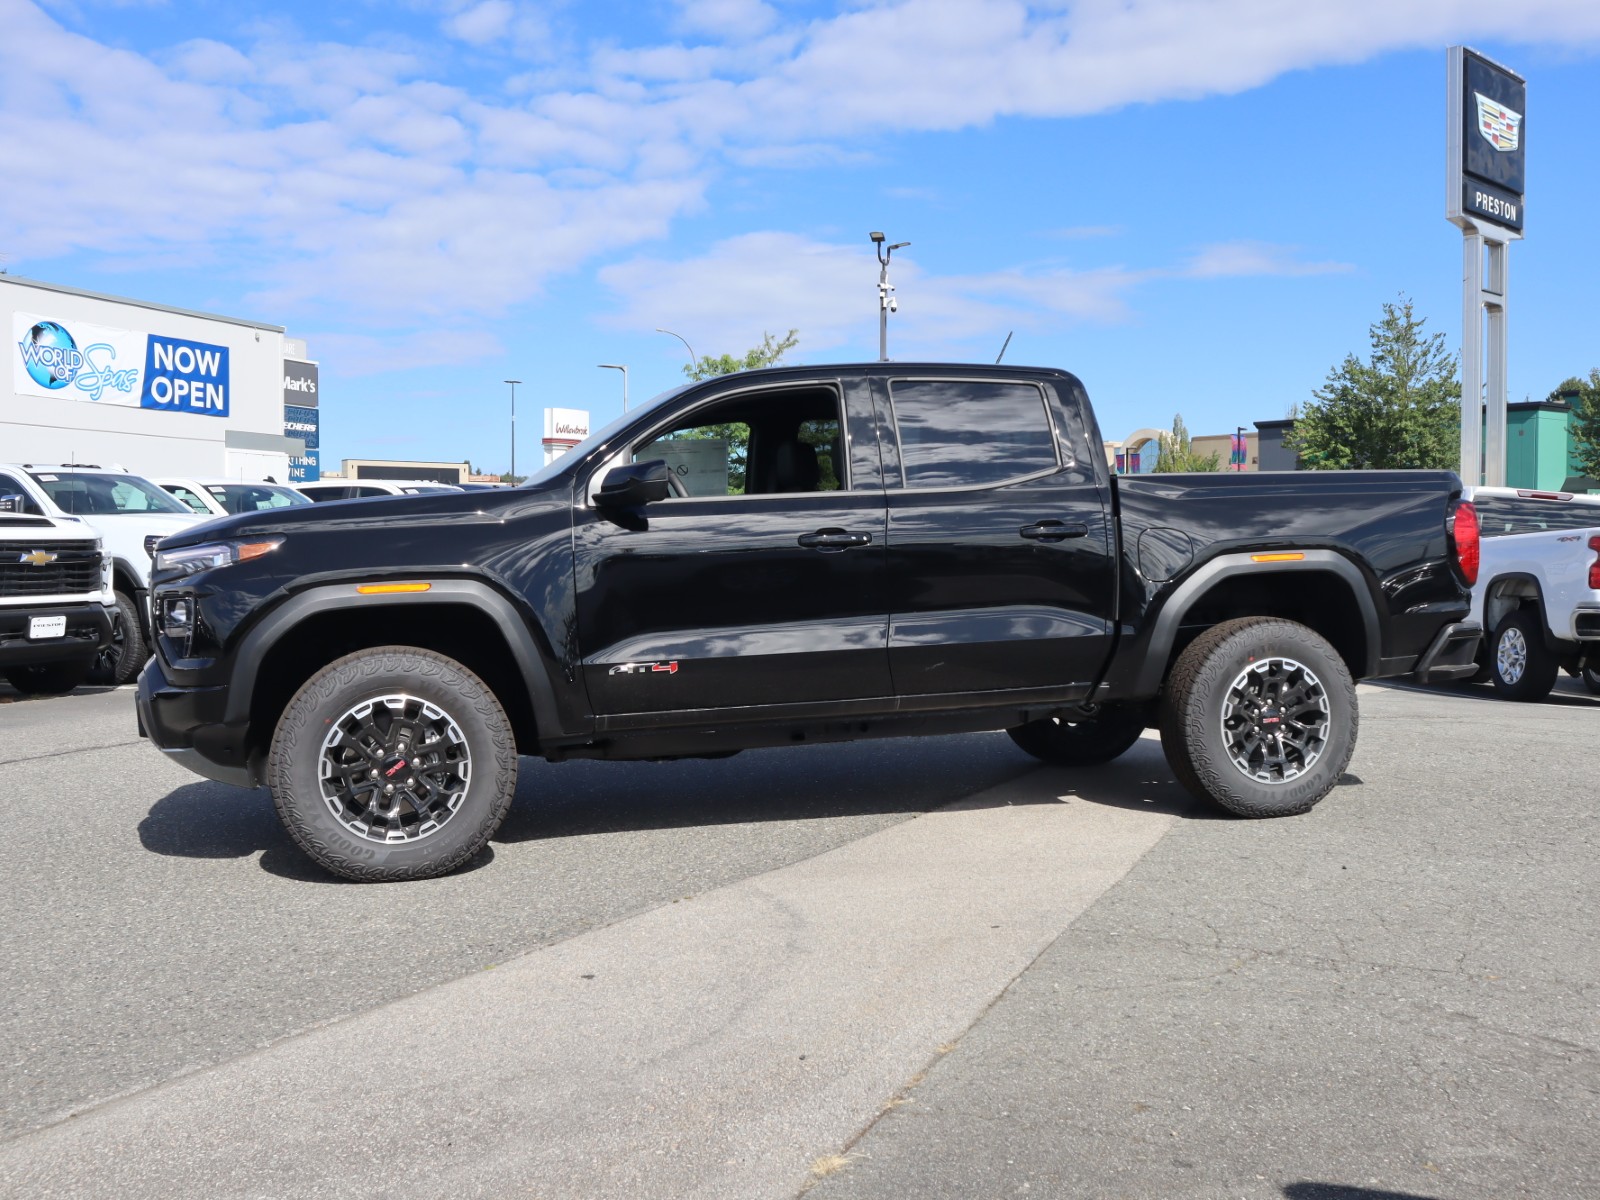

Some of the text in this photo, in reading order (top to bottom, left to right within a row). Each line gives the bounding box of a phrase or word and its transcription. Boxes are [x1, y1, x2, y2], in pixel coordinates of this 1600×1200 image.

[1475, 191, 1516, 222] PRESTON
[18, 341, 84, 369] WORLD
[154, 342, 220, 377] NOW
[54, 367, 73, 383] OF
[75, 343, 138, 400] Spas
[151, 376, 223, 410] OPEN
[608, 661, 678, 676] AT4
